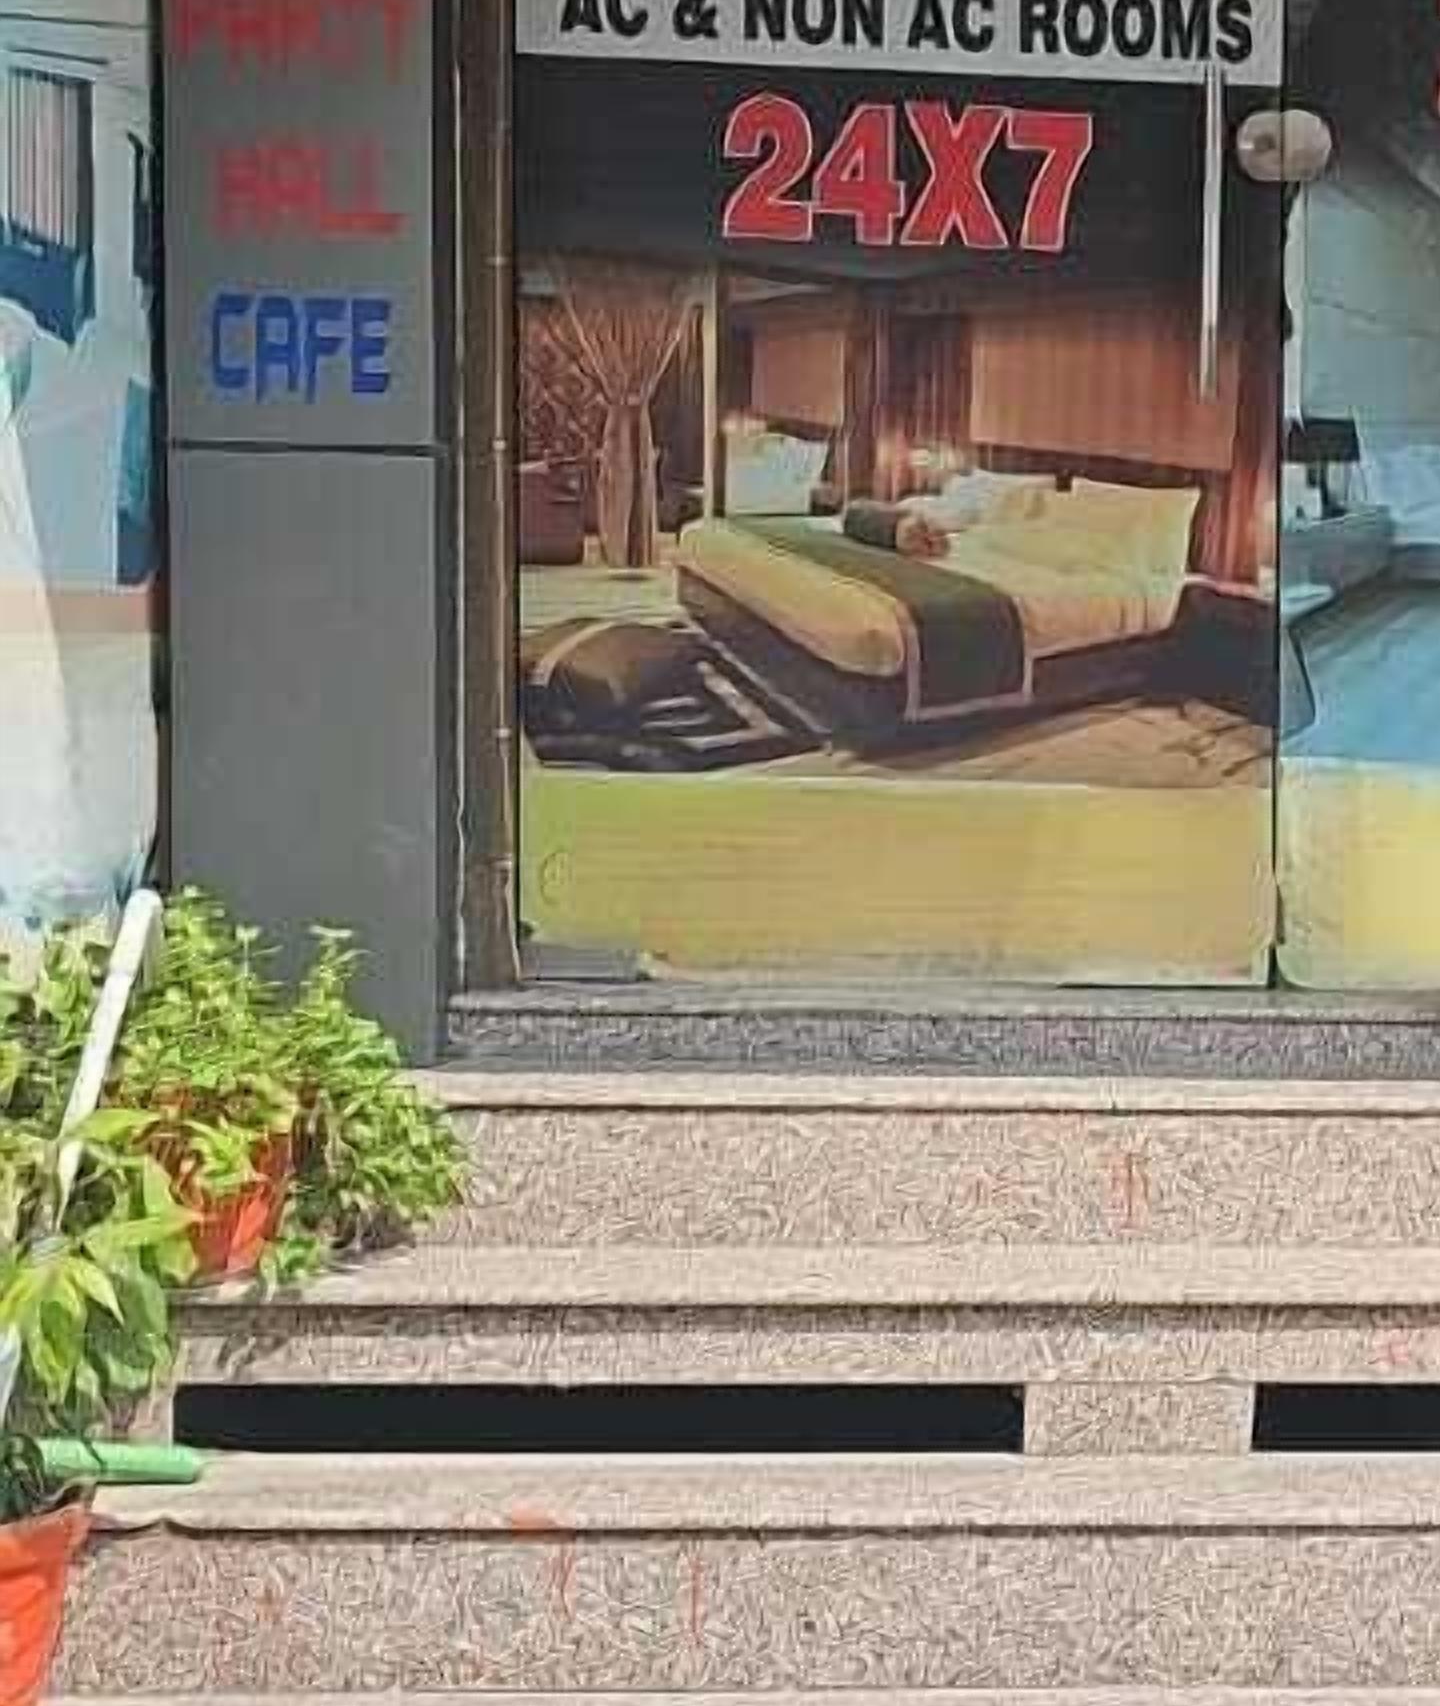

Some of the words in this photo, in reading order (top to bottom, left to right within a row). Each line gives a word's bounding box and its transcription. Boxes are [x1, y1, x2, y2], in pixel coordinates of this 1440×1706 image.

[213, 138, 411, 244] HALL
[721, 90, 1094, 253] 24X7
[210, 292, 392, 405] CAFE
